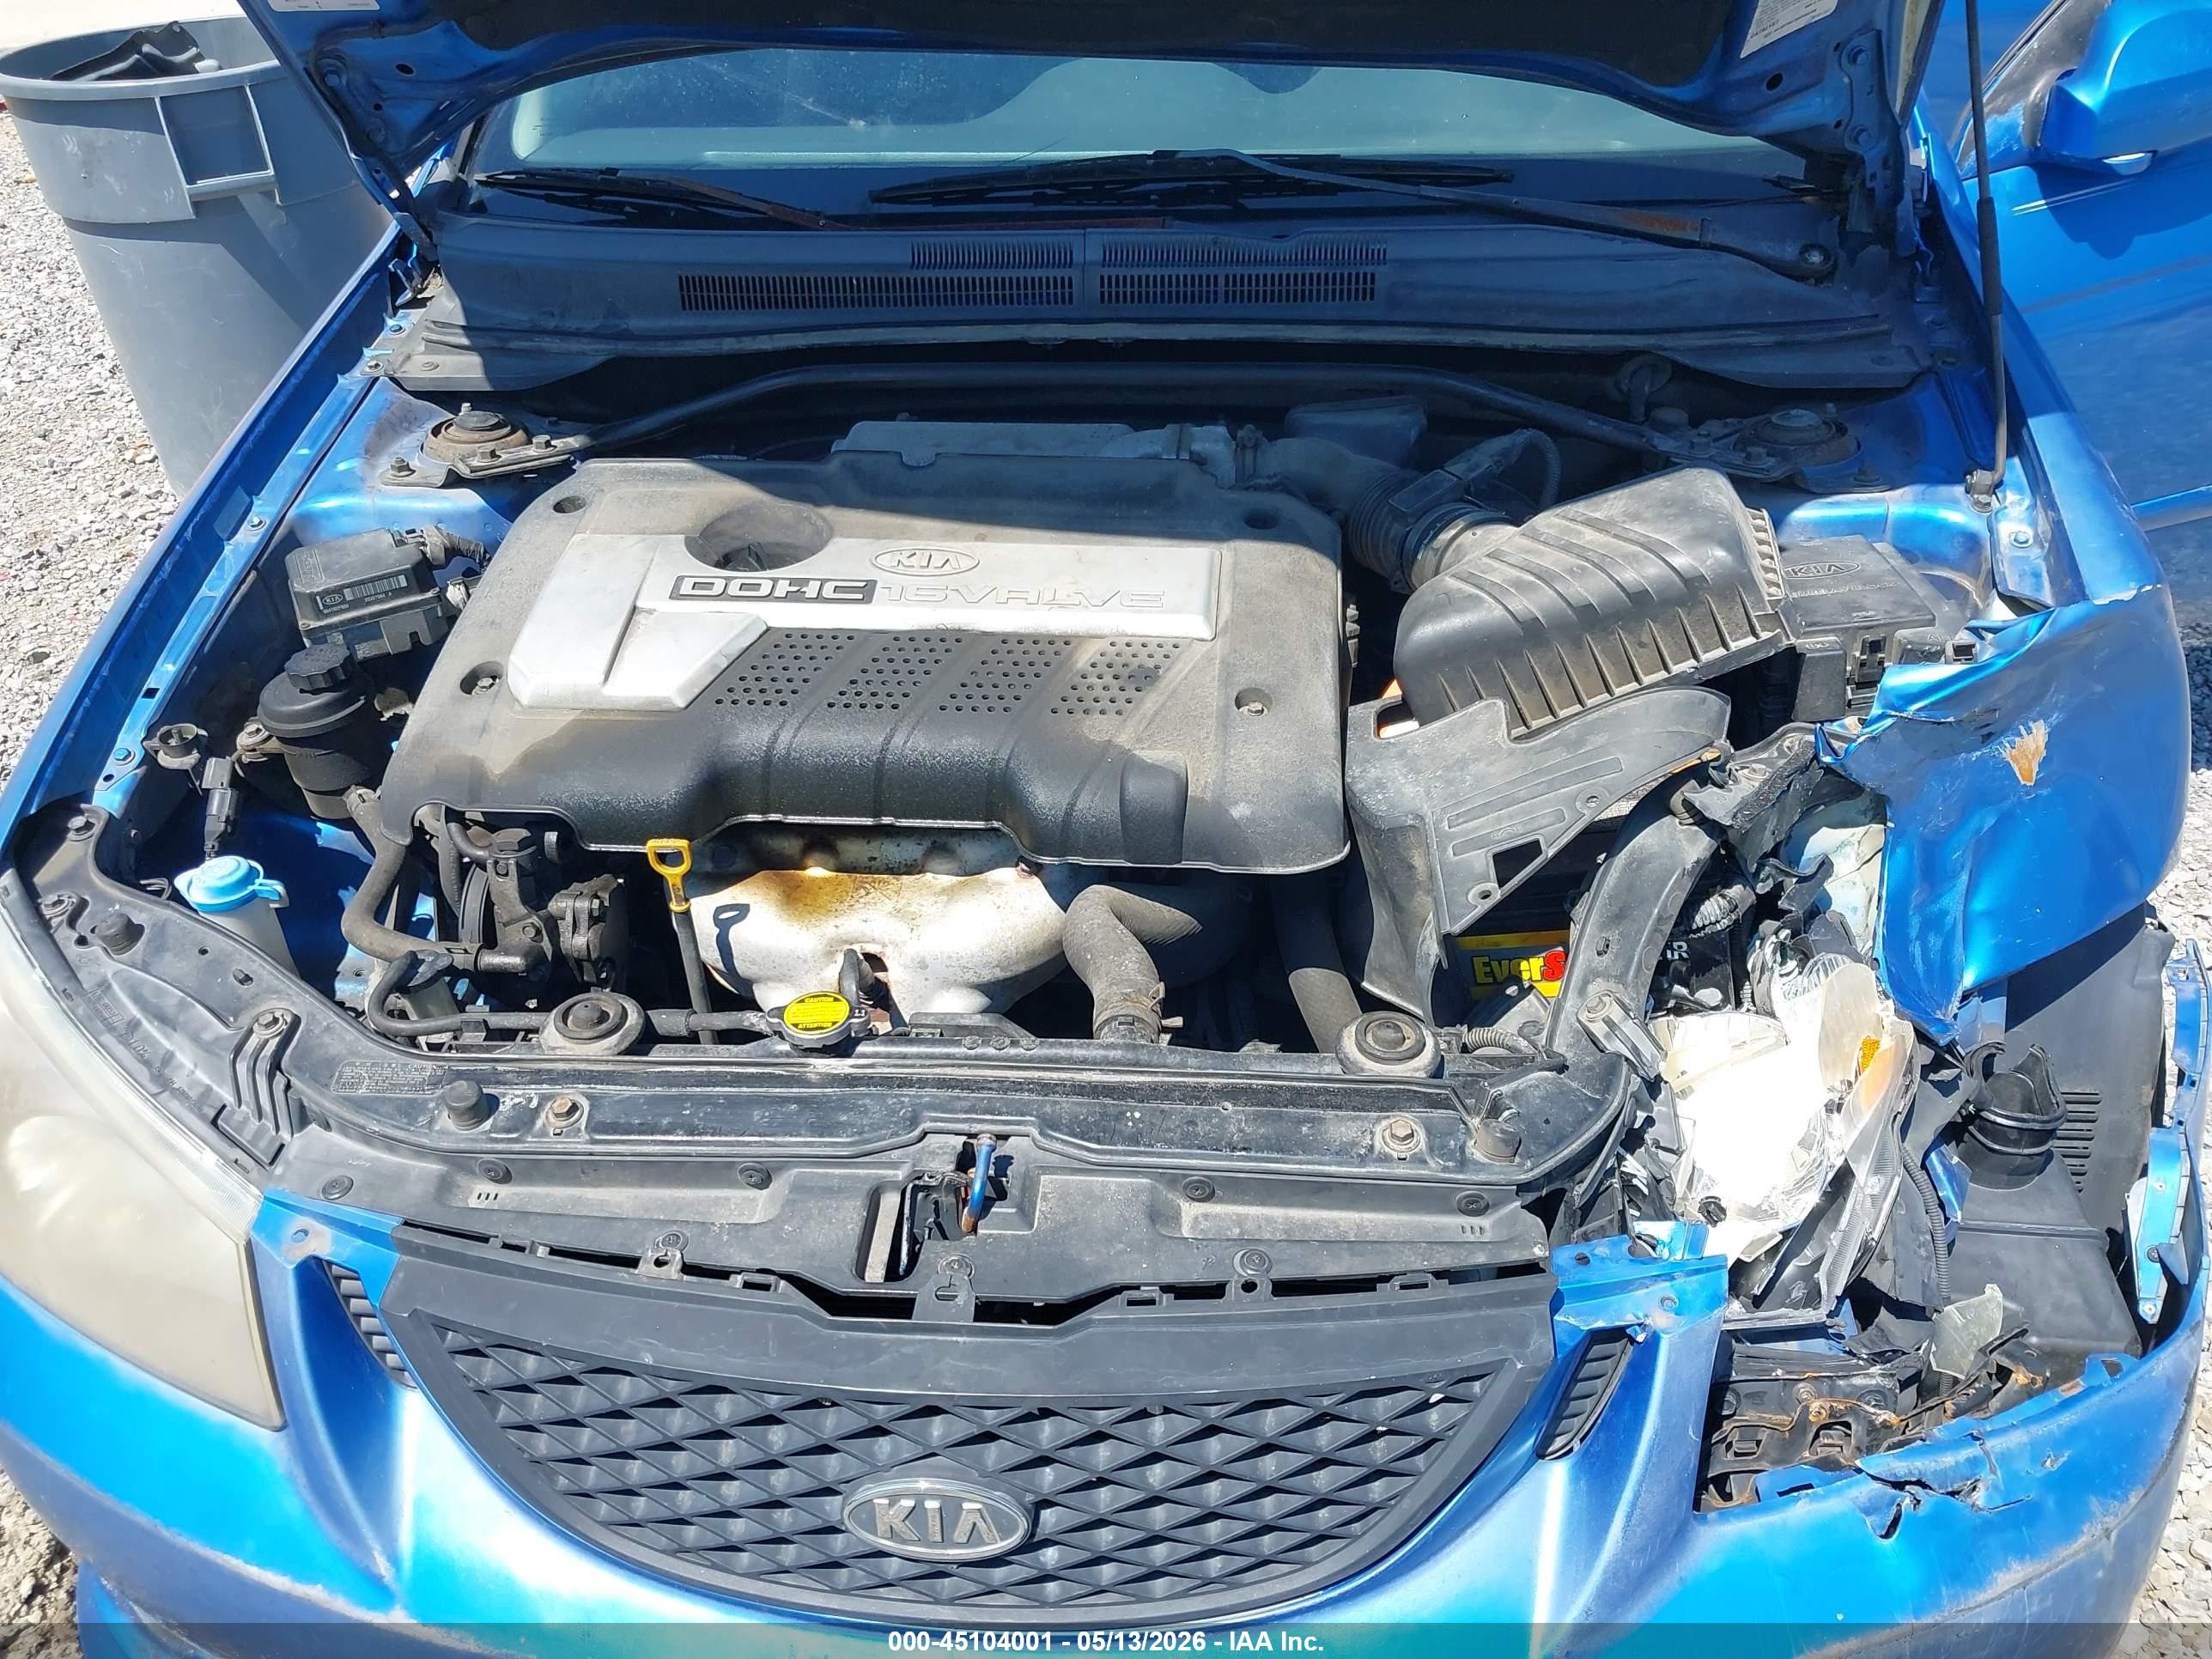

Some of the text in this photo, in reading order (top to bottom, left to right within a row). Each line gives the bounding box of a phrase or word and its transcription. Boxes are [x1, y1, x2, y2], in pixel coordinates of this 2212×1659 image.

[890, 550, 962, 569] KIA
[1791, 563, 1845, 577] KIA
[678, 576, 868, 600] DOHC
[872, 1498, 1002, 1544] KIA
